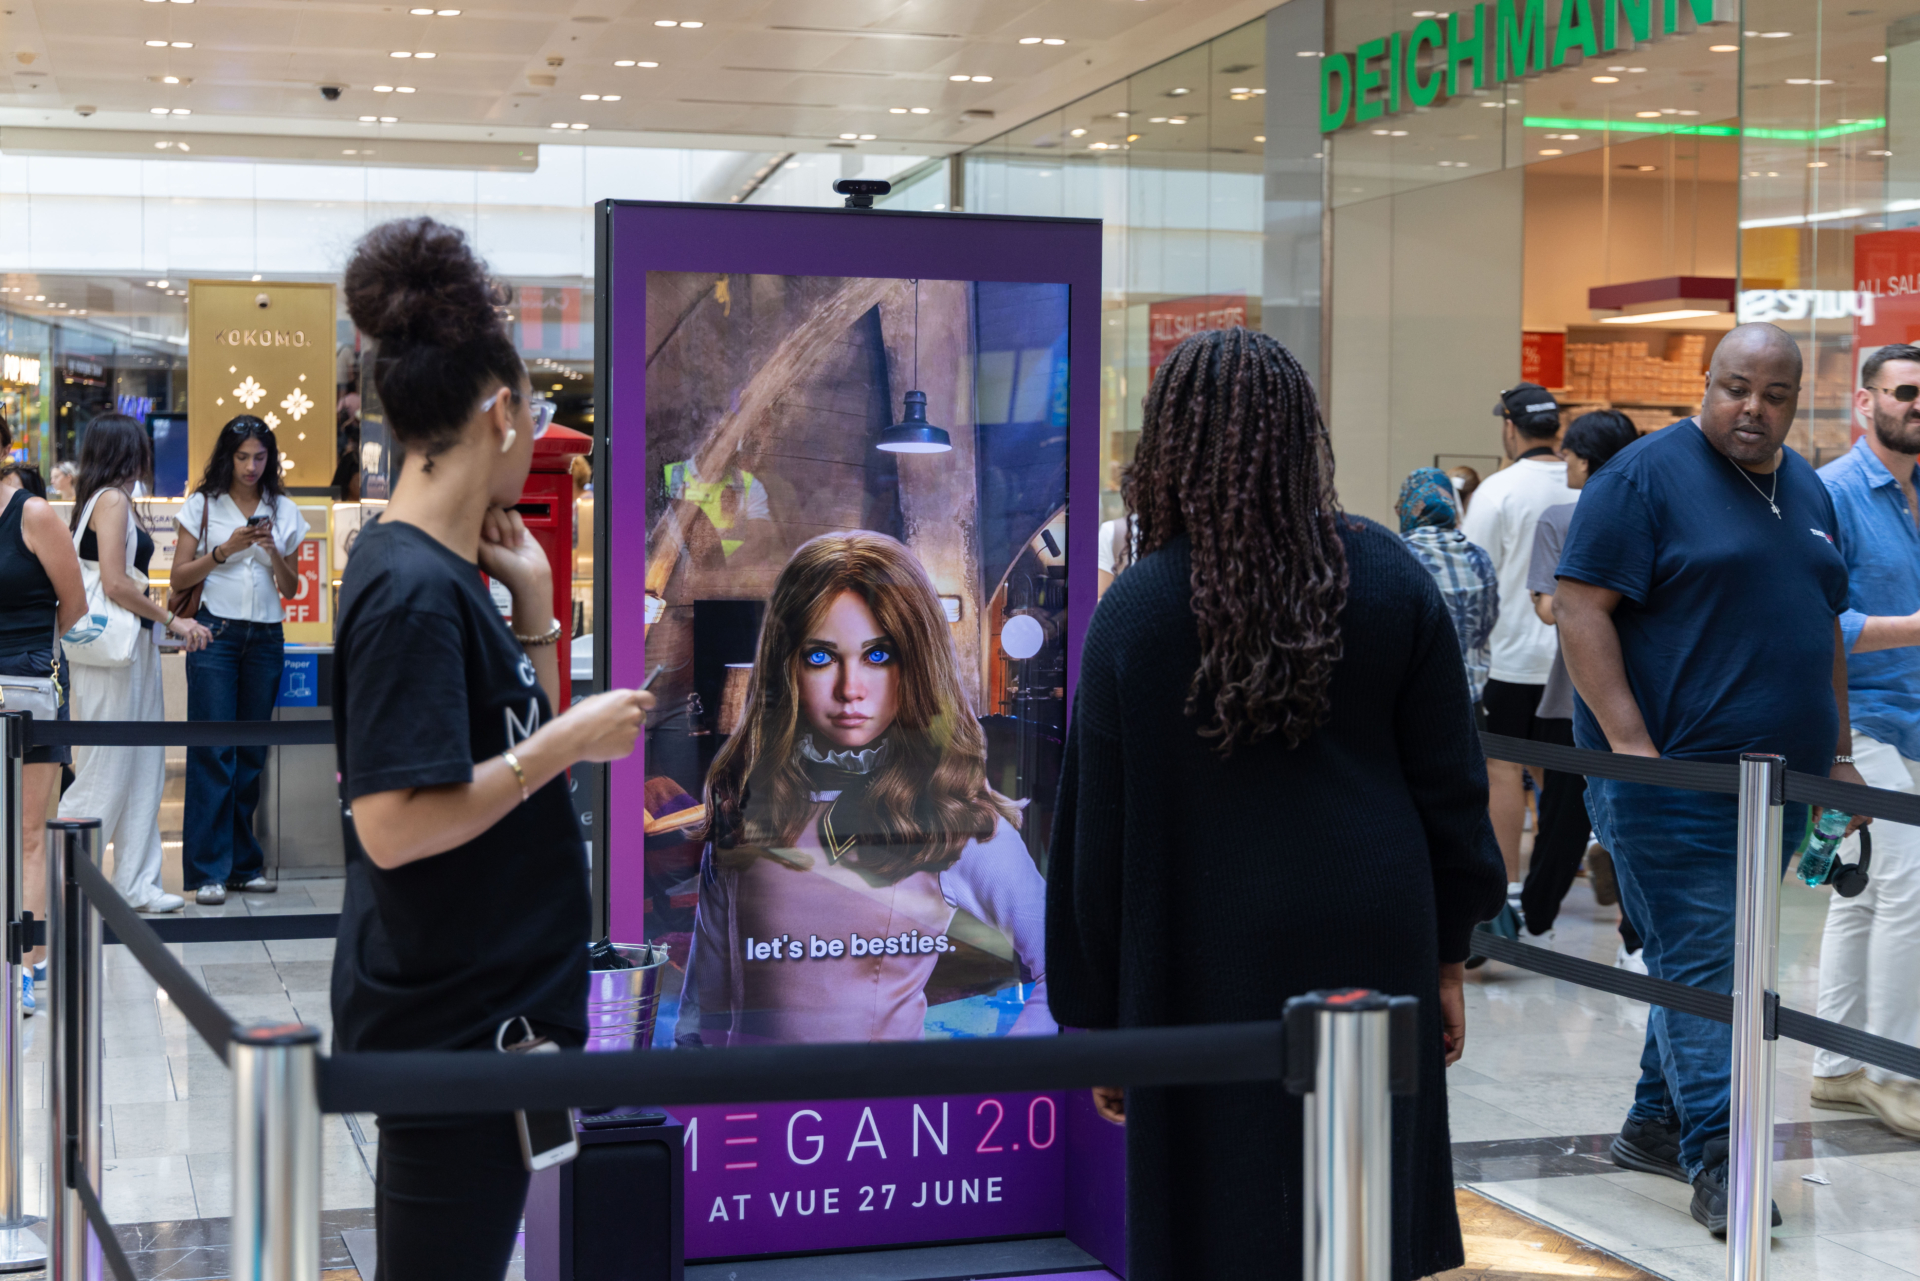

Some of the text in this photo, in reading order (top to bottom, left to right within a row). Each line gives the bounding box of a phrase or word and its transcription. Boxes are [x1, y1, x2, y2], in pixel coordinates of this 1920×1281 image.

[1887, 273, 1920, 297] SAL
[284, 660, 311, 669] Paper
[746, 929, 957, 960] let's be besties.
[975, 1096, 1056, 1154] 2.0
[708, 1177, 1003, 1222] AT VUE 27 JUNE
